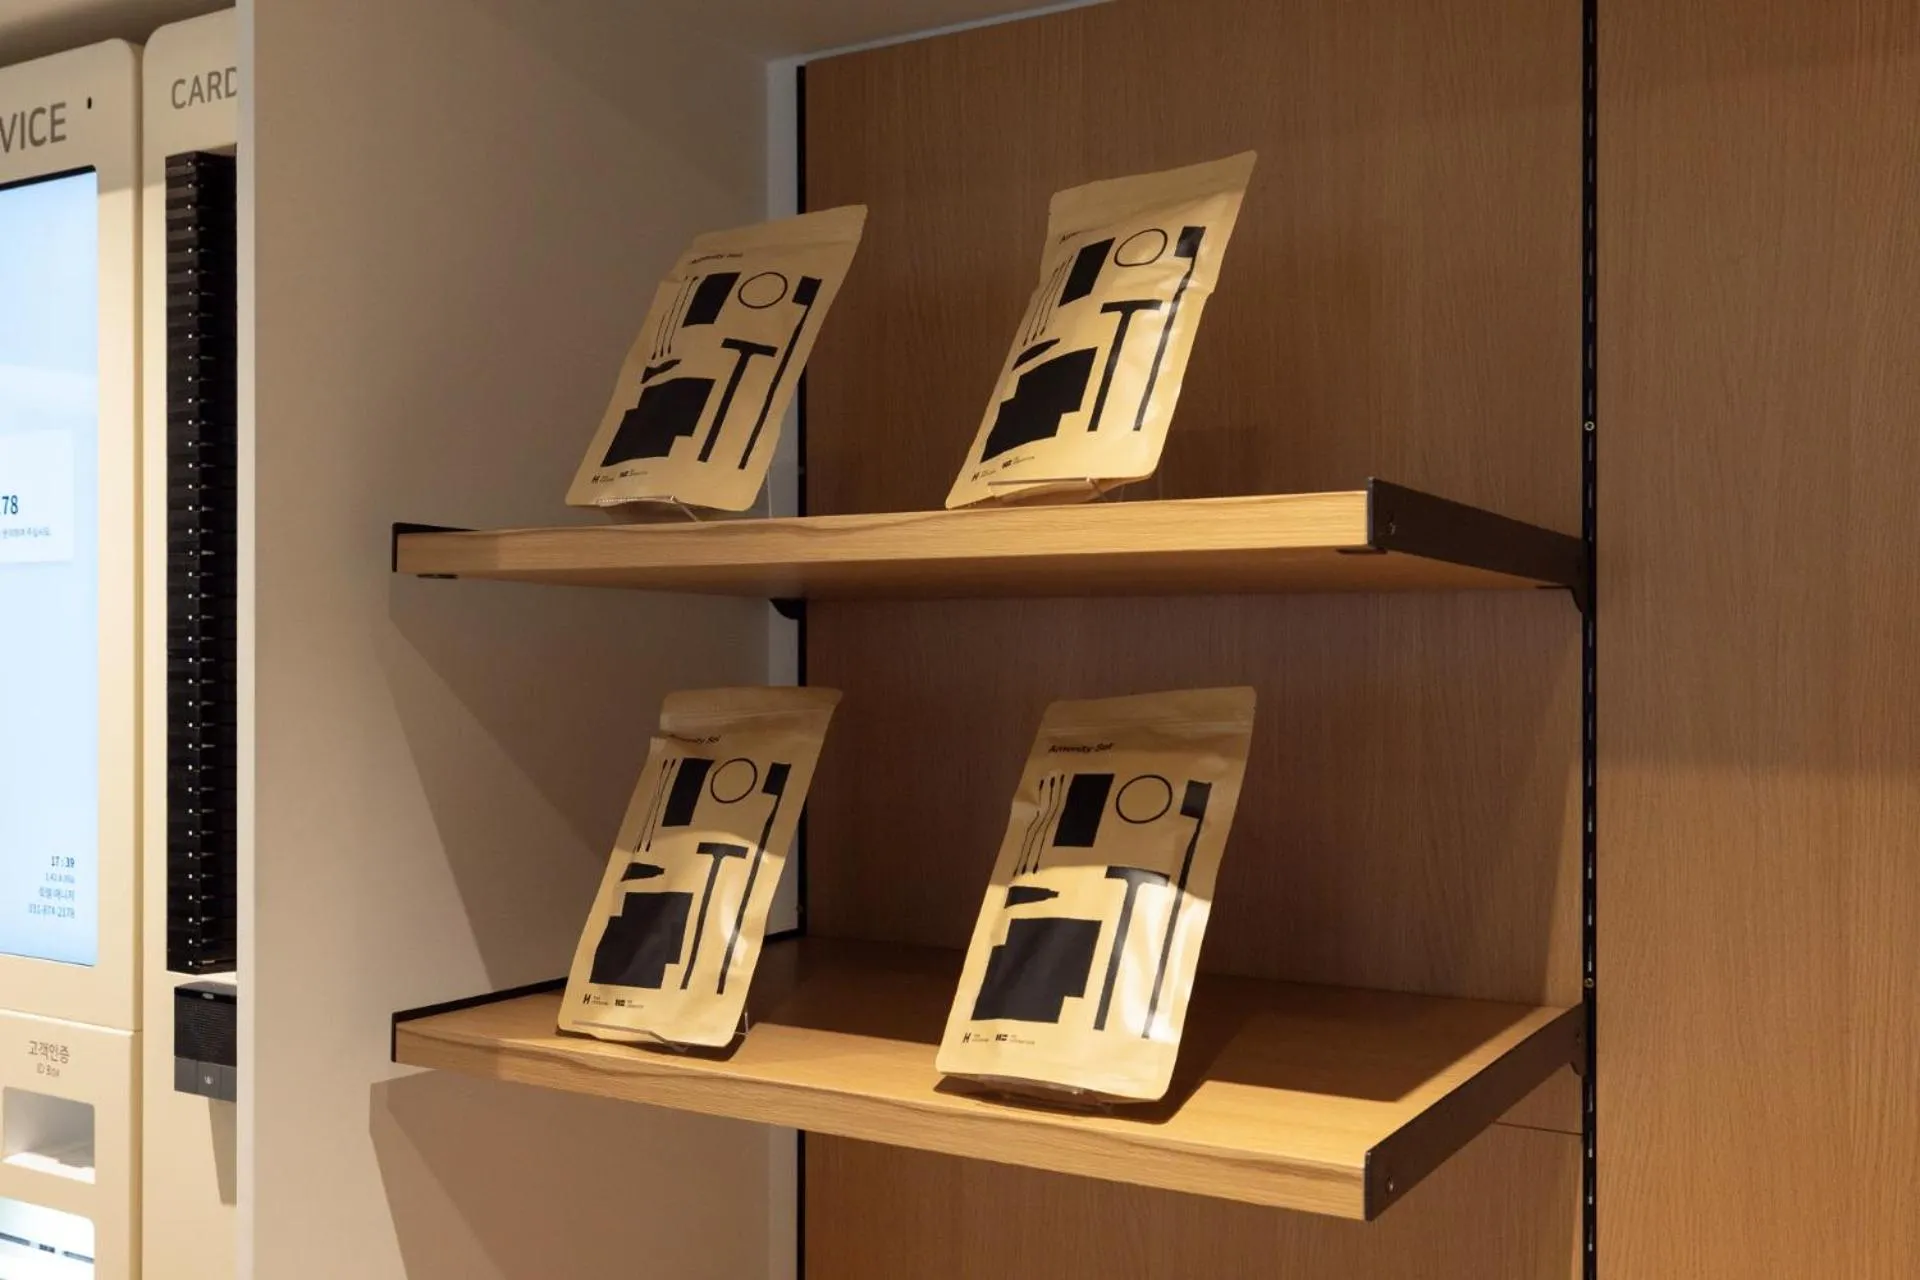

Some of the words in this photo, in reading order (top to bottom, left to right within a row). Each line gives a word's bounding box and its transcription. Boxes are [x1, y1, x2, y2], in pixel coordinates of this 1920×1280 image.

[0, 102, 67, 154] VICE
[0, 494, 19, 516] 78
[28, 1040, 70, 1064] 고객인증
